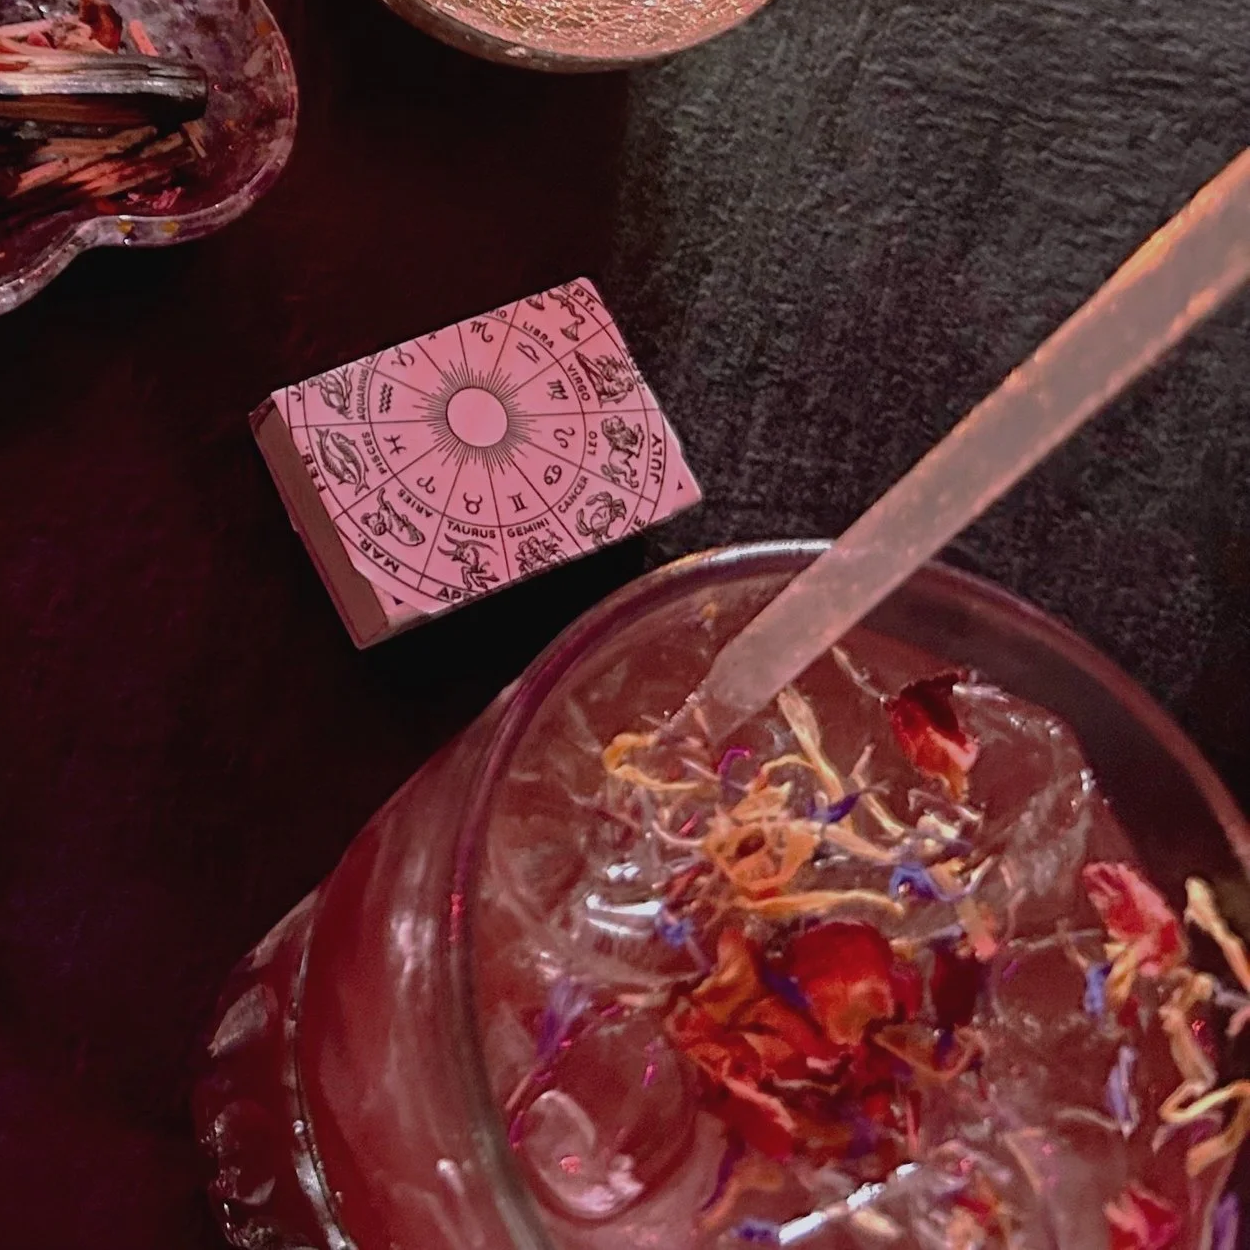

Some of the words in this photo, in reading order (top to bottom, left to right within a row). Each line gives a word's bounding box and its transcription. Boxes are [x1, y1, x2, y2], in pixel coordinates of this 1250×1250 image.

[522, 321, 555, 349] LIBRA
[356, 368, 370, 421] AQUARIUS
[566, 363, 590, 402] VIRGO
[361, 432, 388, 475] PISCES
[586, 430, 597, 456] LEO
[649, 433, 664, 485] JULY
[397, 489, 434, 518] ARIES
[557, 475, 590, 514] CANCER
[446, 520, 497, 539] TAURUS
[507, 517, 551, 538] GEMINI
[357, 533, 401, 573] MAR.
